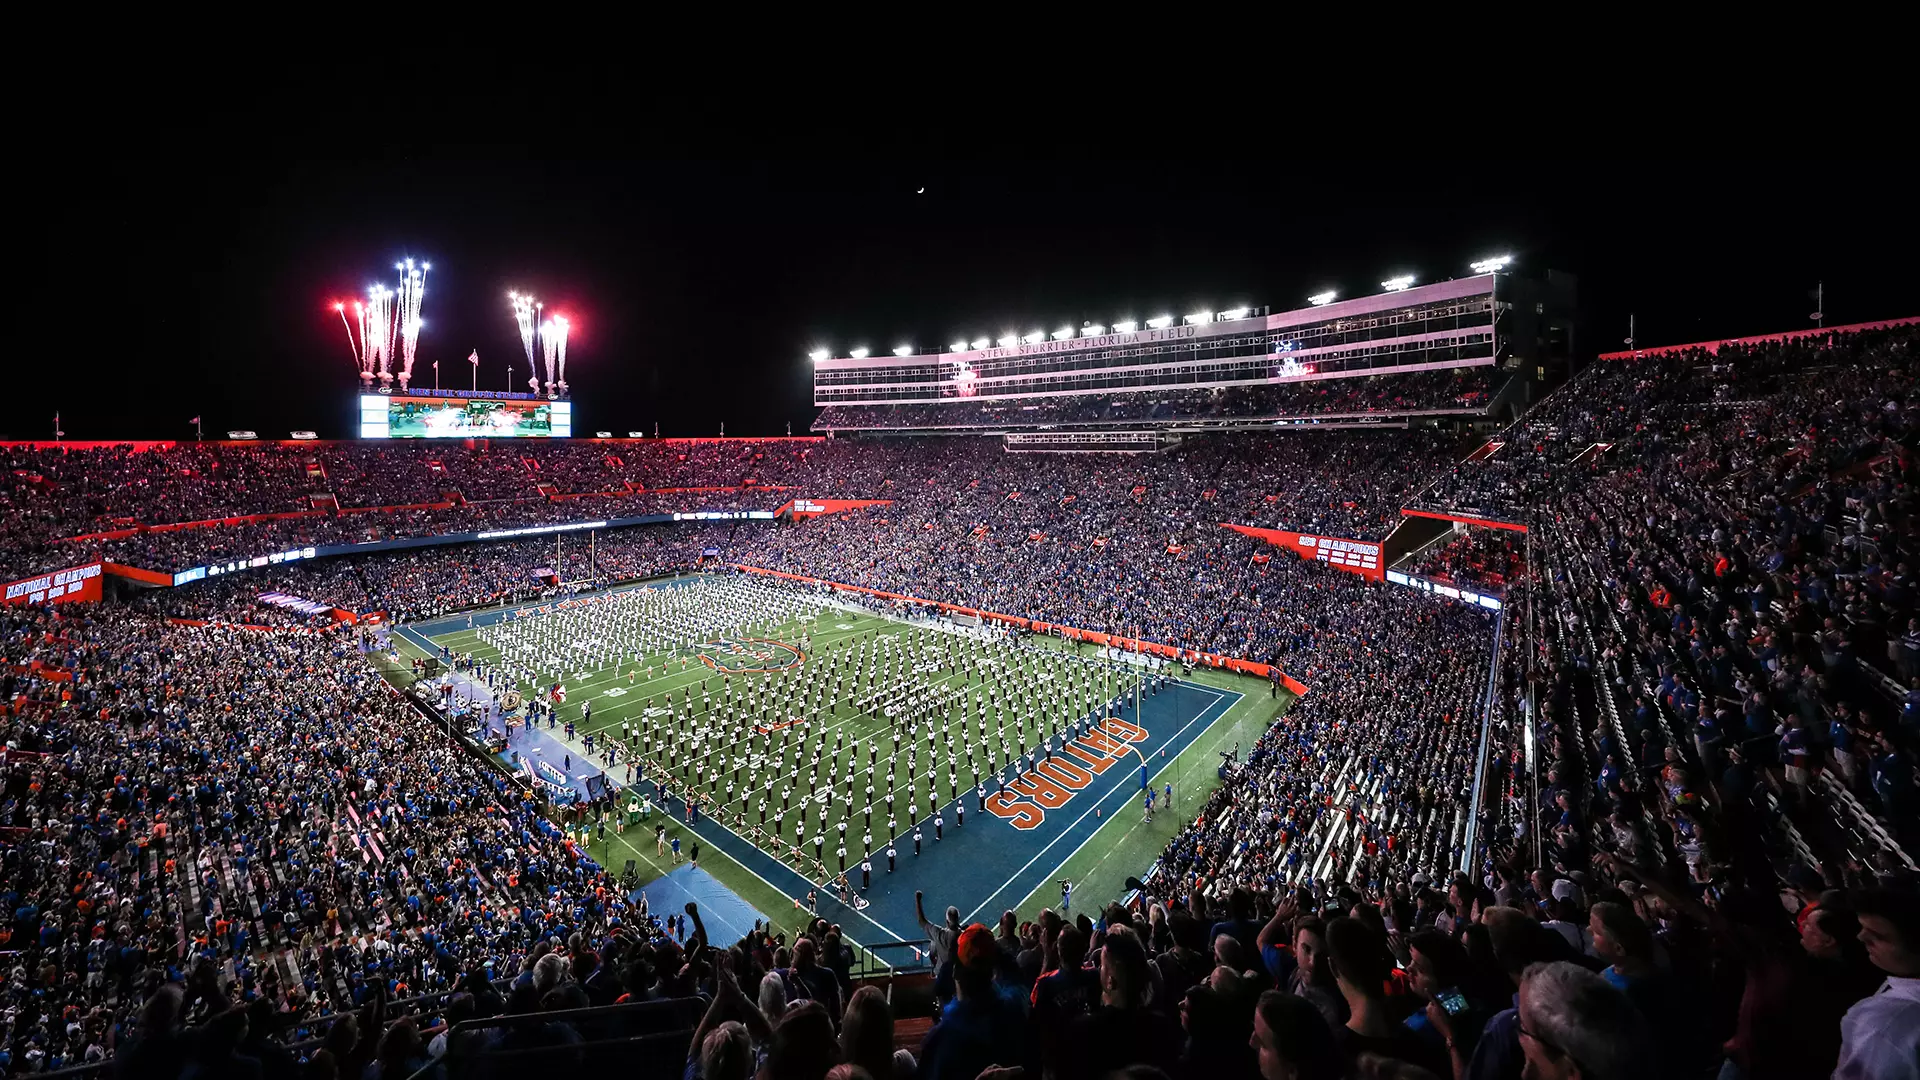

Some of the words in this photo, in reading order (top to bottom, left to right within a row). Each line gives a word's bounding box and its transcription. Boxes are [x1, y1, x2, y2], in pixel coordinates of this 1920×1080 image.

[980, 349, 1011, 359] STEVE
[1150, 326, 1195, 341] FIELD
[1298, 536, 1316, 548] SEC
[1318, 539, 1379, 557] CHAMPIONS
[6, 576, 51, 599] NATIONAL
[53, 564, 101, 587] CHAMPIONS
[985, 717, 1150, 831] GATORS
